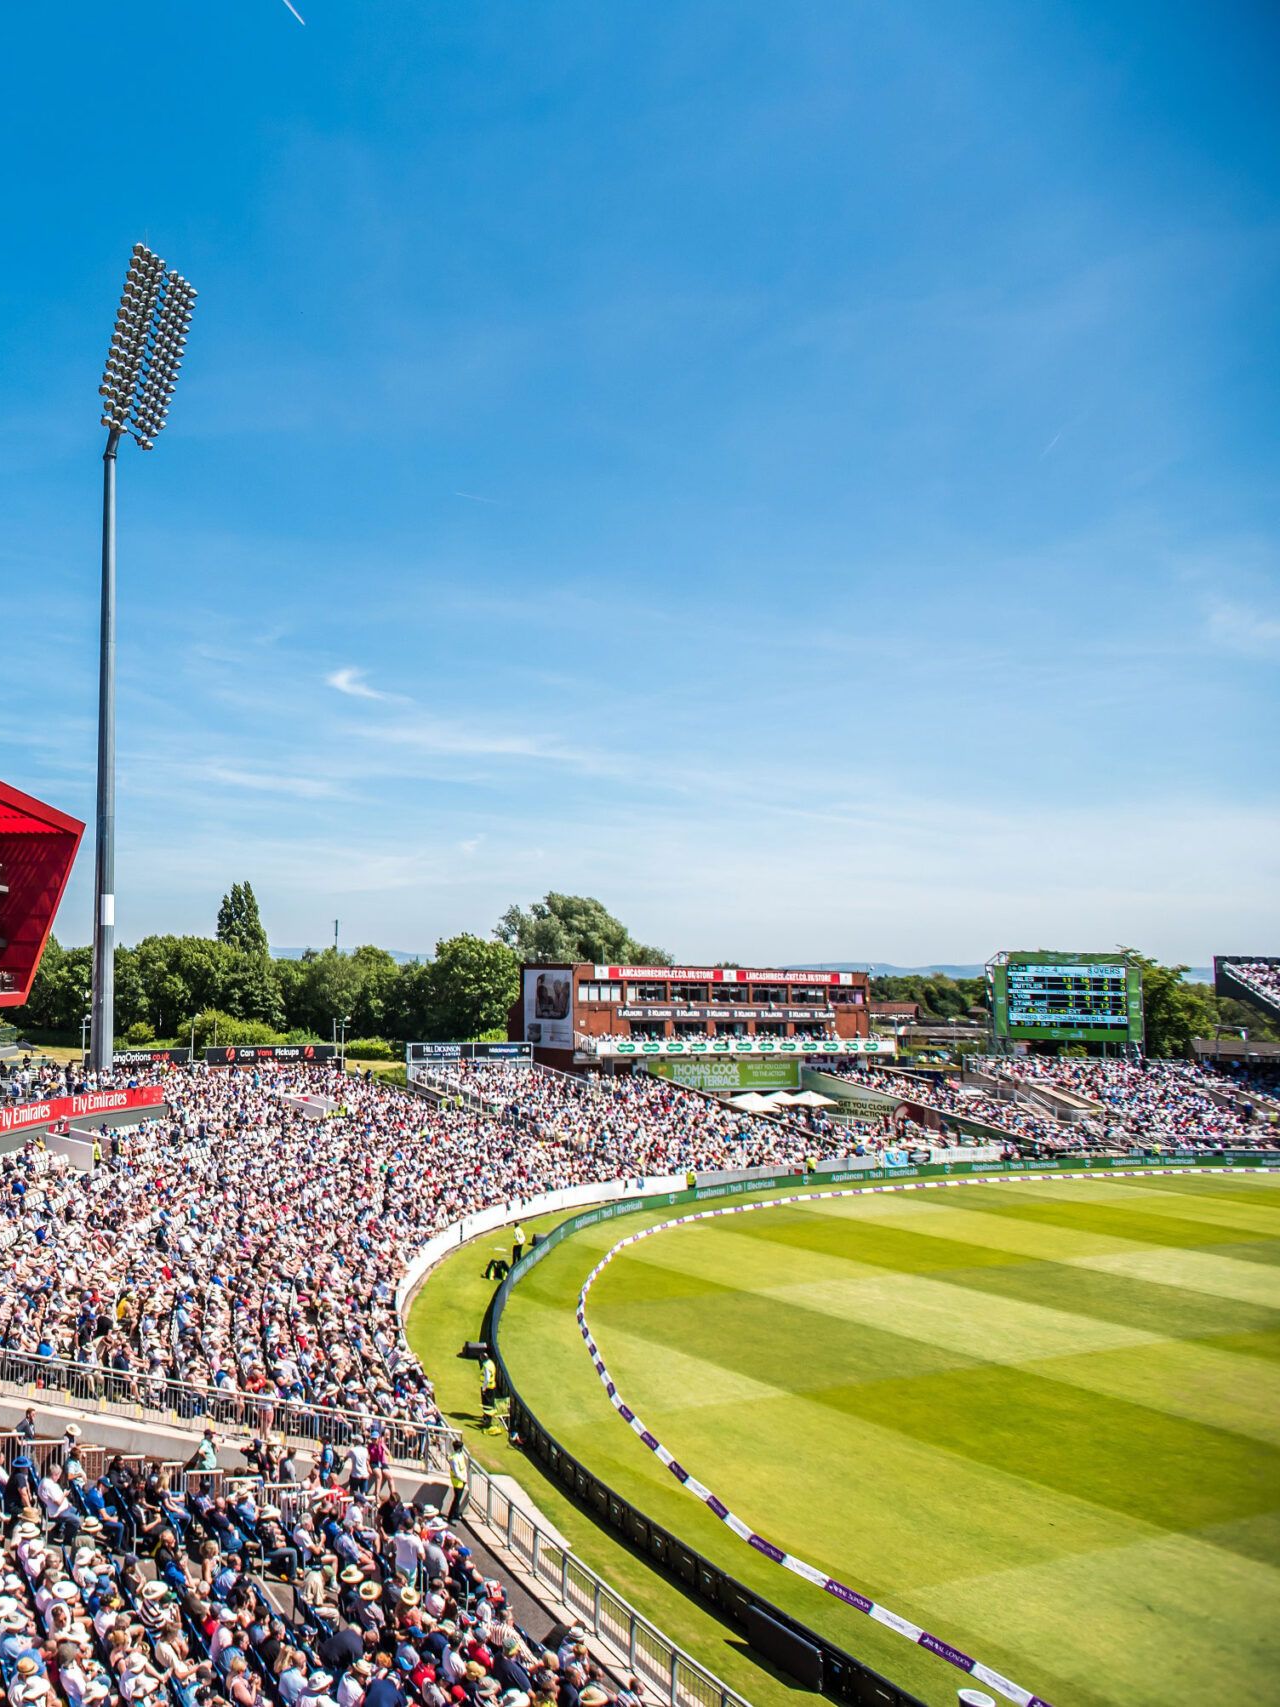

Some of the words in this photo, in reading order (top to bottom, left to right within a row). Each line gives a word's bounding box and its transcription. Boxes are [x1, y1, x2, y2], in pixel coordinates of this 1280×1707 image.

[1094, 966, 1121, 974] OVERS
[256, 1049, 273, 1057] Vans
[275, 1048, 300, 1058] Pickups
[423, 1045, 434, 1053] HILL
[435, 1045, 461, 1053] DICKINSON
[672, 1063, 711, 1075] THOMAS
[711, 1063, 739, 1075] COOK
[672, 1075, 702, 1086] SPORT
[702, 1075, 740, 1087] TERRACE
[72, 1096, 87, 1114] Fly
[88, 1092, 127, 1110] Emirates
[838, 1100, 851, 1108] GET
[852, 1101, 867, 1110] YOU
[867, 1103, 895, 1112] CLOSER
[13, 1104, 51, 1123] Emirates
[846, 1108, 859, 1116] THE
[972, 1163, 1004, 1172] Appliances
[1009, 1162, 1024, 1170] Tech
[1029, 1161, 1060, 1169] Electricals
[1111, 1158, 1142, 1167] Appliances
[1145, 1157, 1160, 1165] Tech
[1164, 1157, 1196, 1165] Electricals
[831, 1171, 864, 1183] Appliances
[869, 1169, 883, 1179] Tech
[888, 1167, 919, 1178] Electricals
[695, 1186, 725, 1199] Appliances
[729, 1184, 743, 1194] Tech
[747, 1180, 776, 1191] Electricals
[616, 1200, 643, 1214] Electricals
[927, 1639, 945, 1653] ROYAL
[945, 1650, 970, 1667] LONDON
